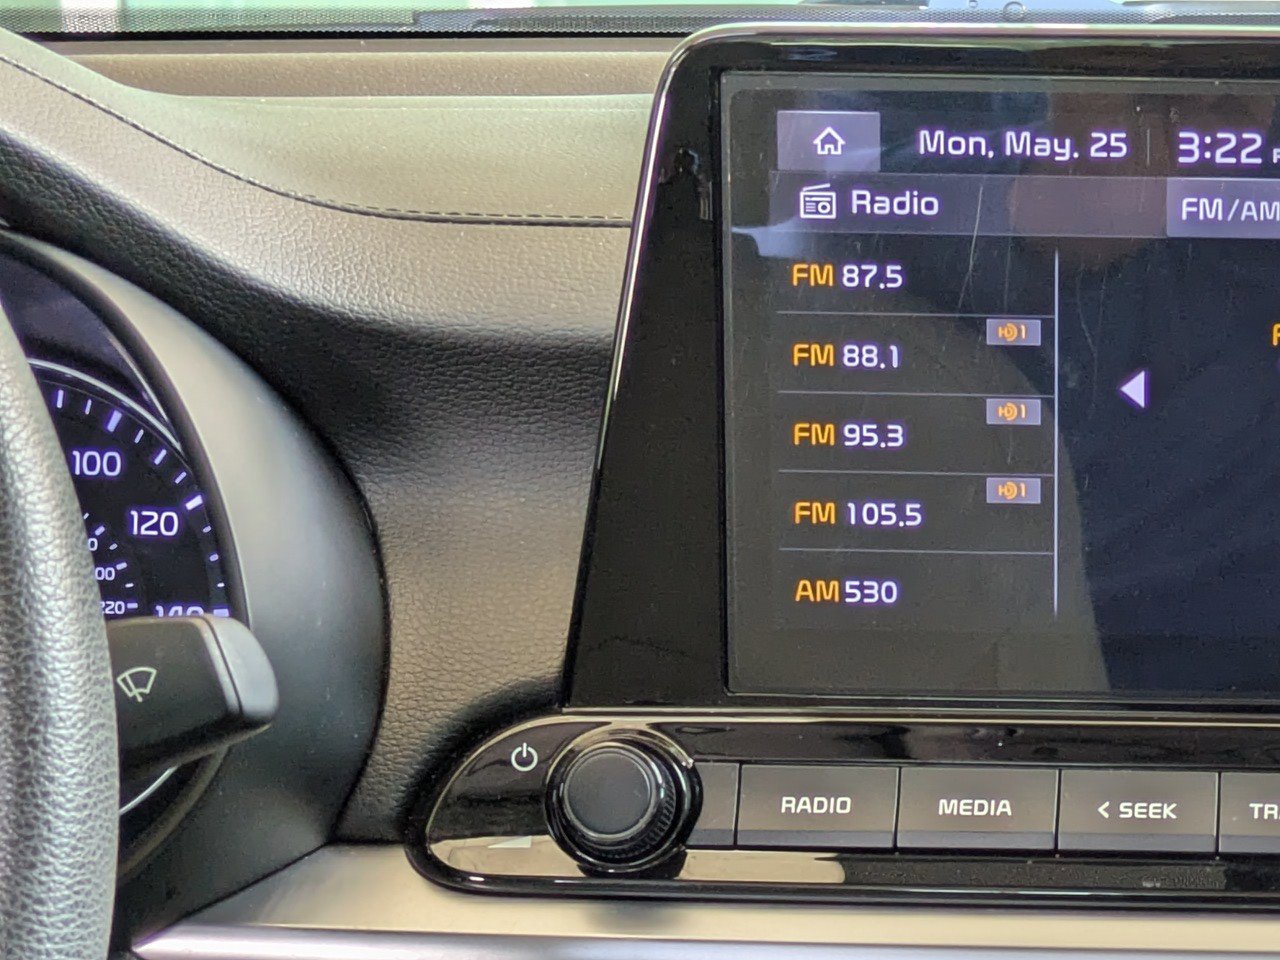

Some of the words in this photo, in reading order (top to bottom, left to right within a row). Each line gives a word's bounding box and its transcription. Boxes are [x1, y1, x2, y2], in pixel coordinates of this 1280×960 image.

[918, 130, 994, 158] Mon,
[1005, 131, 1079, 159] May.
[1090, 132, 1128, 158] 25
[1177, 131, 1263, 165] 3:22
[851, 190, 940, 217] Radio
[1181, 198, 1280, 222] FM/AM
[792, 264, 834, 287] FM
[842, 265, 903, 290] 87.5
[792, 344, 835, 366] FM
[843, 345, 899, 369] 88.1
[793, 423, 836, 446] FM
[843, 424, 905, 448] 95.3
[72, 450, 122, 477] 100
[130, 510, 179, 536] 120
[794, 502, 837, 525] FM
[847, 502, 923, 527] 105.5
[94, 567, 116, 581] 00
[795, 579, 840, 603] AM
[844, 580, 898, 604] 530
[781, 796, 853, 815] RADIO
[938, 799, 1012, 817] MEDIA
[1119, 802, 1177, 820] SEEK
